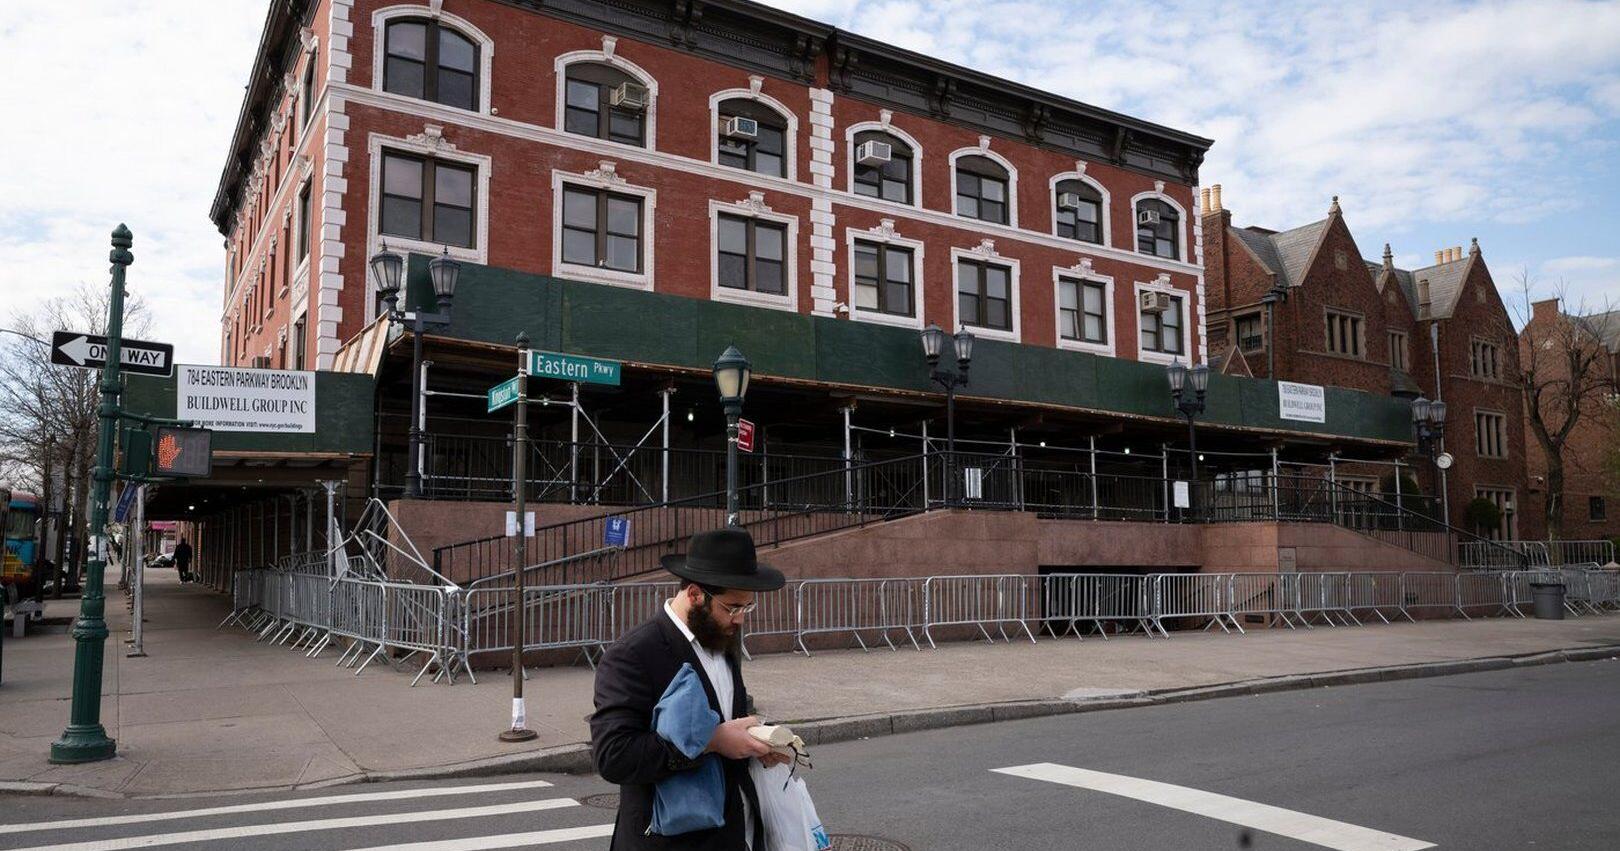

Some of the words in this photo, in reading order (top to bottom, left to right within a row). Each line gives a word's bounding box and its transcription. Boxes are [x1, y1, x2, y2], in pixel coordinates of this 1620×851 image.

[127, 349, 160, 365] WAY
[537, 355, 588, 378] Eastern
[594, 362, 614, 377] Pkwy
[187, 369, 200, 385] 784
[201, 370, 235, 387] EASTERN
[236, 372, 270, 389] PARKWAY
[271, 374, 308, 390] BROOKLYN
[187, 395, 250, 412] BUILDWELL
[252, 398, 288, 413] GROUP
[290, 400, 308, 414] INC
